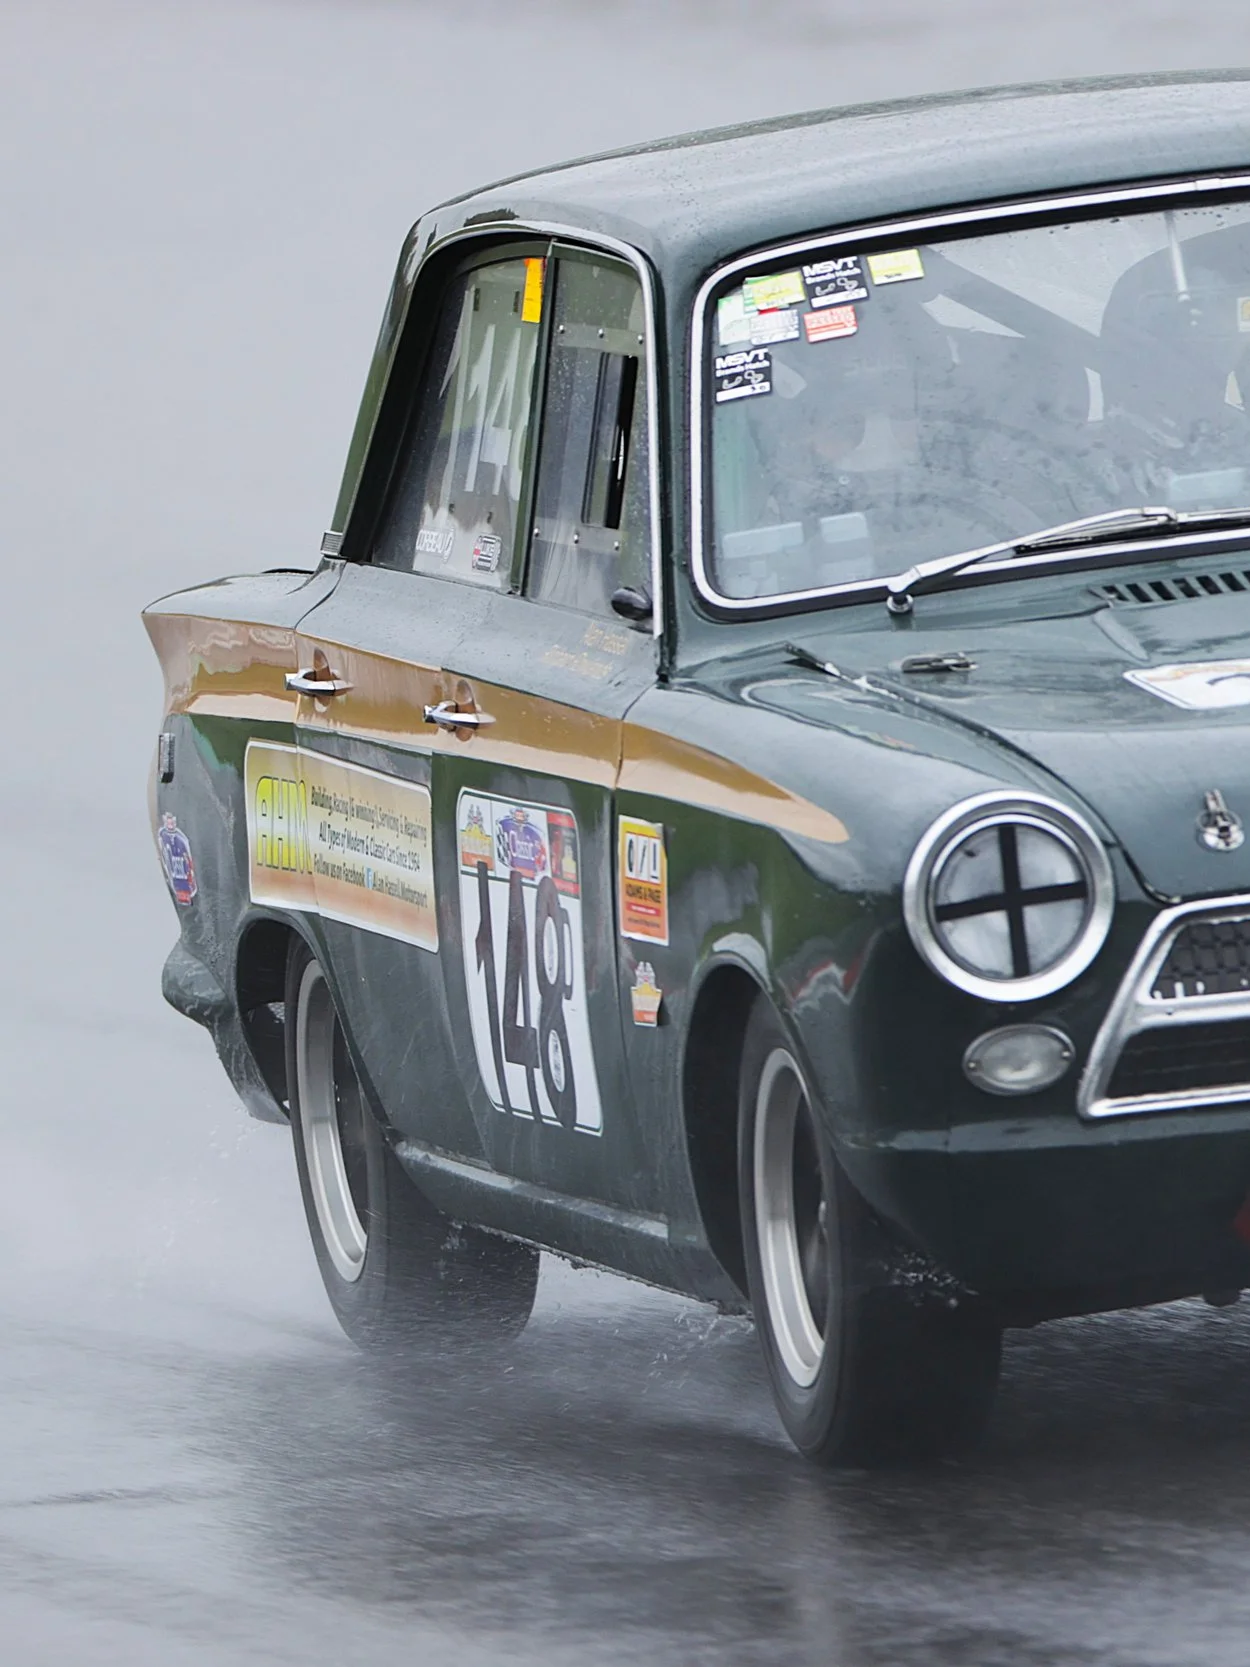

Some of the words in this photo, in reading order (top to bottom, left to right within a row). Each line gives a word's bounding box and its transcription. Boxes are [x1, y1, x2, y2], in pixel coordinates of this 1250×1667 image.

[802, 256, 858, 277] MSVT
[716, 348, 769, 370] MSVT
[343, 862, 365, 888] Facebook
[475, 861, 578, 1129] 148
